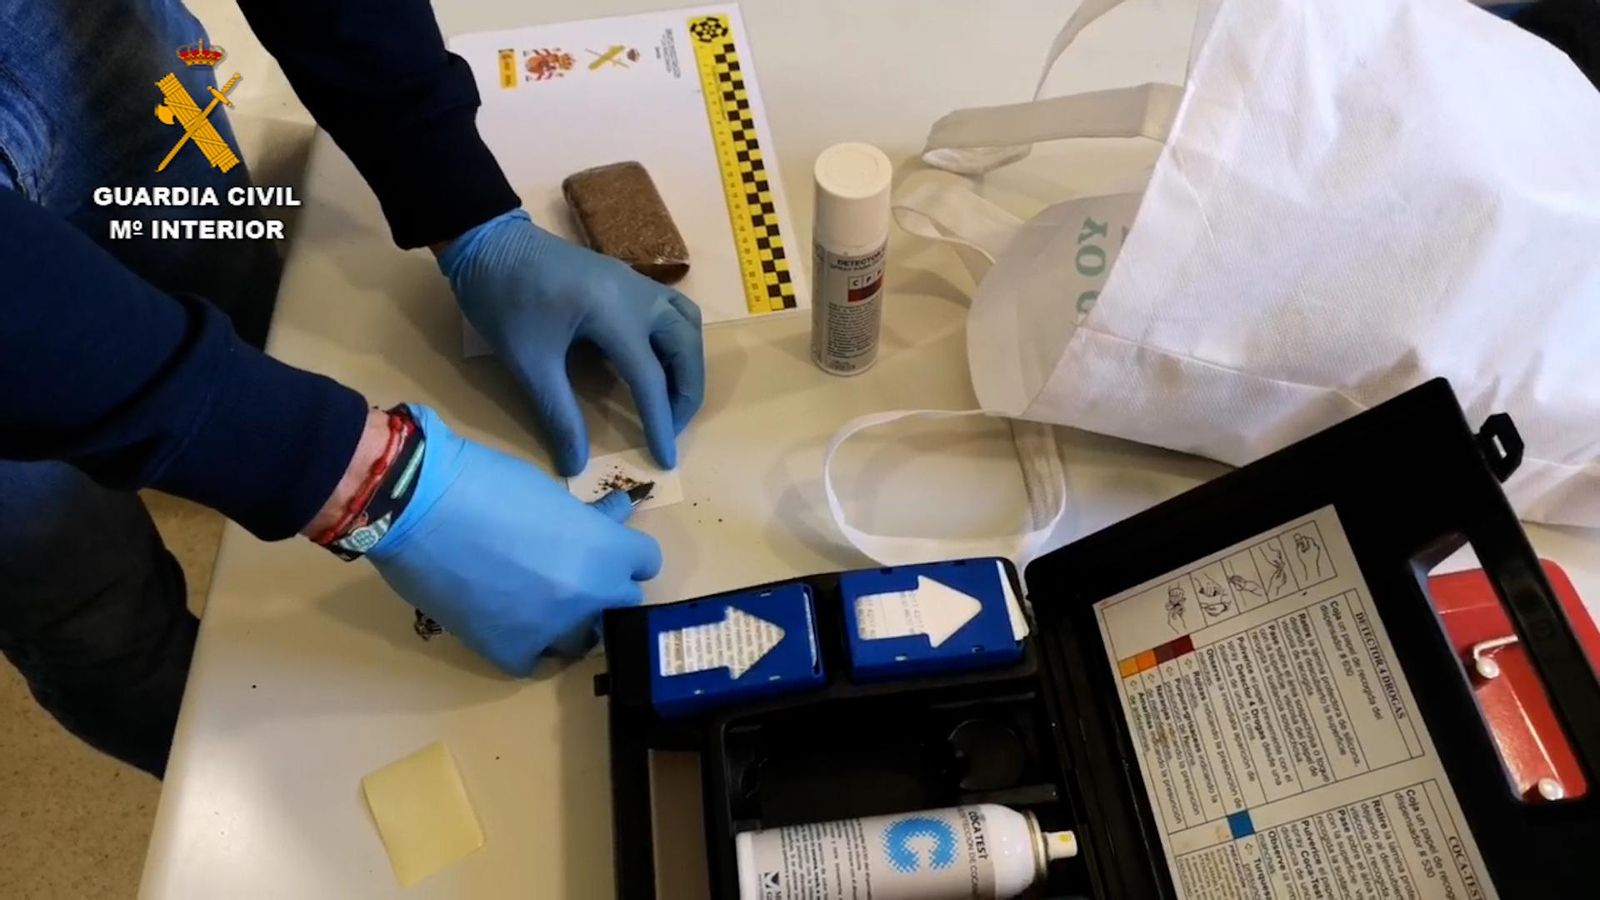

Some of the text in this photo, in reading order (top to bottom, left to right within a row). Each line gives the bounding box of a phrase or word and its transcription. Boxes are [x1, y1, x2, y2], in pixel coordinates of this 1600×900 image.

[1251, 630, 1267, 664] recogida
[1258, 628, 1268, 642] con
[1281, 620, 1296, 648] viscosa
[1292, 649, 1300, 660] de
[1319, 604, 1343, 651] dispensador
[1205, 647, 1221, 682] Observe
[1217, 643, 1233, 677] distancia
[1229, 678, 1237, 689] de
[1233, 690, 1245, 710] unos
[1241, 711, 1250, 722] 15
[1263, 665, 1270, 673] la
[1268, 652, 1286, 690] superficie
[1297, 612, 1311, 638] Retire
[1307, 639, 1315, 647] la
[1320, 675, 1342, 718] protectora
[1337, 718, 1347, 730] de
[1329, 599, 1383, 720] Coja un papel de recogida del
[1355, 611, 1383, 666] DETECTOR
[1381, 675, 1404, 719] DROGAS
[1217, 683, 1224, 691] la
[1236, 635, 1293, 782] Pulverice el papel brevemente con el
[1266, 674, 1284, 712] sustancia
[1267, 624, 1279, 645] Pase
[1275, 645, 1288, 669] sobre
[1283, 669, 1292, 677] el
[1294, 698, 1317, 748] sospechosa
[1315, 756, 1330, 782] toque
[1283, 694, 1298, 725] viscosa
[1288, 616, 1346, 755] dejando al descubierto la superficie
[1137, 691, 1152, 729] Amarillas
[1149, 730, 1164, 768] indicando
[1160, 769, 1167, 778] la
[1155, 684, 1170, 720] Naranjas
[1166, 722, 1182, 760] indicando
[1178, 760, 1185, 769] la
[1178, 723, 1186, 734] de
[1220, 692, 1237, 730] inmediata
[1226, 640, 1238, 661] spray
[1235, 663, 1252, 698] Detector
[1250, 707, 1266, 740] Drogas
[1261, 741, 1275, 767] desde
[1271, 768, 1282, 786] una
[1294, 726, 1305, 739] del
[1192, 670, 1206, 701] Rojizas
[1203, 702, 1219, 740] indicando
[1215, 740, 1222, 749] la
[1233, 796, 1242, 809] de
[1298, 740, 1314, 764] papel
[1197, 754, 1214, 793] indicando
[1211, 794, 1217, 803] la
[1246, 770, 1255, 781] de
[1308, 765, 1317, 776] de
[1371, 799, 1387, 829] Retire
[1384, 830, 1392, 840] la
[1405, 788, 1420, 812] Coja
[1415, 813, 1426, 826] un
[878, 815, 961, 874] C
[967, 809, 989, 861] COCA TEST
[1301, 819, 1321, 865] Pulverice
[1317, 866, 1327, 876] el
[1316, 815, 1334, 854] recogida
[1331, 854, 1338, 864] la
[1325, 812, 1357, 884] con la superficie
[1337, 808, 1350, 832] Pase
[1346, 834, 1361, 860] sobre
[1356, 861, 1366, 871] el
[1349, 806, 1367, 840] viscosa
[1363, 841, 1373, 854] de
[1360, 802, 1379, 840] dejando
[1375, 841, 1385, 850] al
[1394, 792, 1422, 848] dispensador
[1421, 858, 1435, 878] 530
[1419, 827, 1438, 854] papel
[966, 851, 977, 864] DE
[1267, 830, 1285, 870] Observe
[1281, 872, 1289, 881] la
[1280, 826, 1299, 866] distancia
[1294, 867, 1304, 880] de
[1290, 823, 1323, 899] spray Coca-Test
[1432, 855, 1443, 869] de
